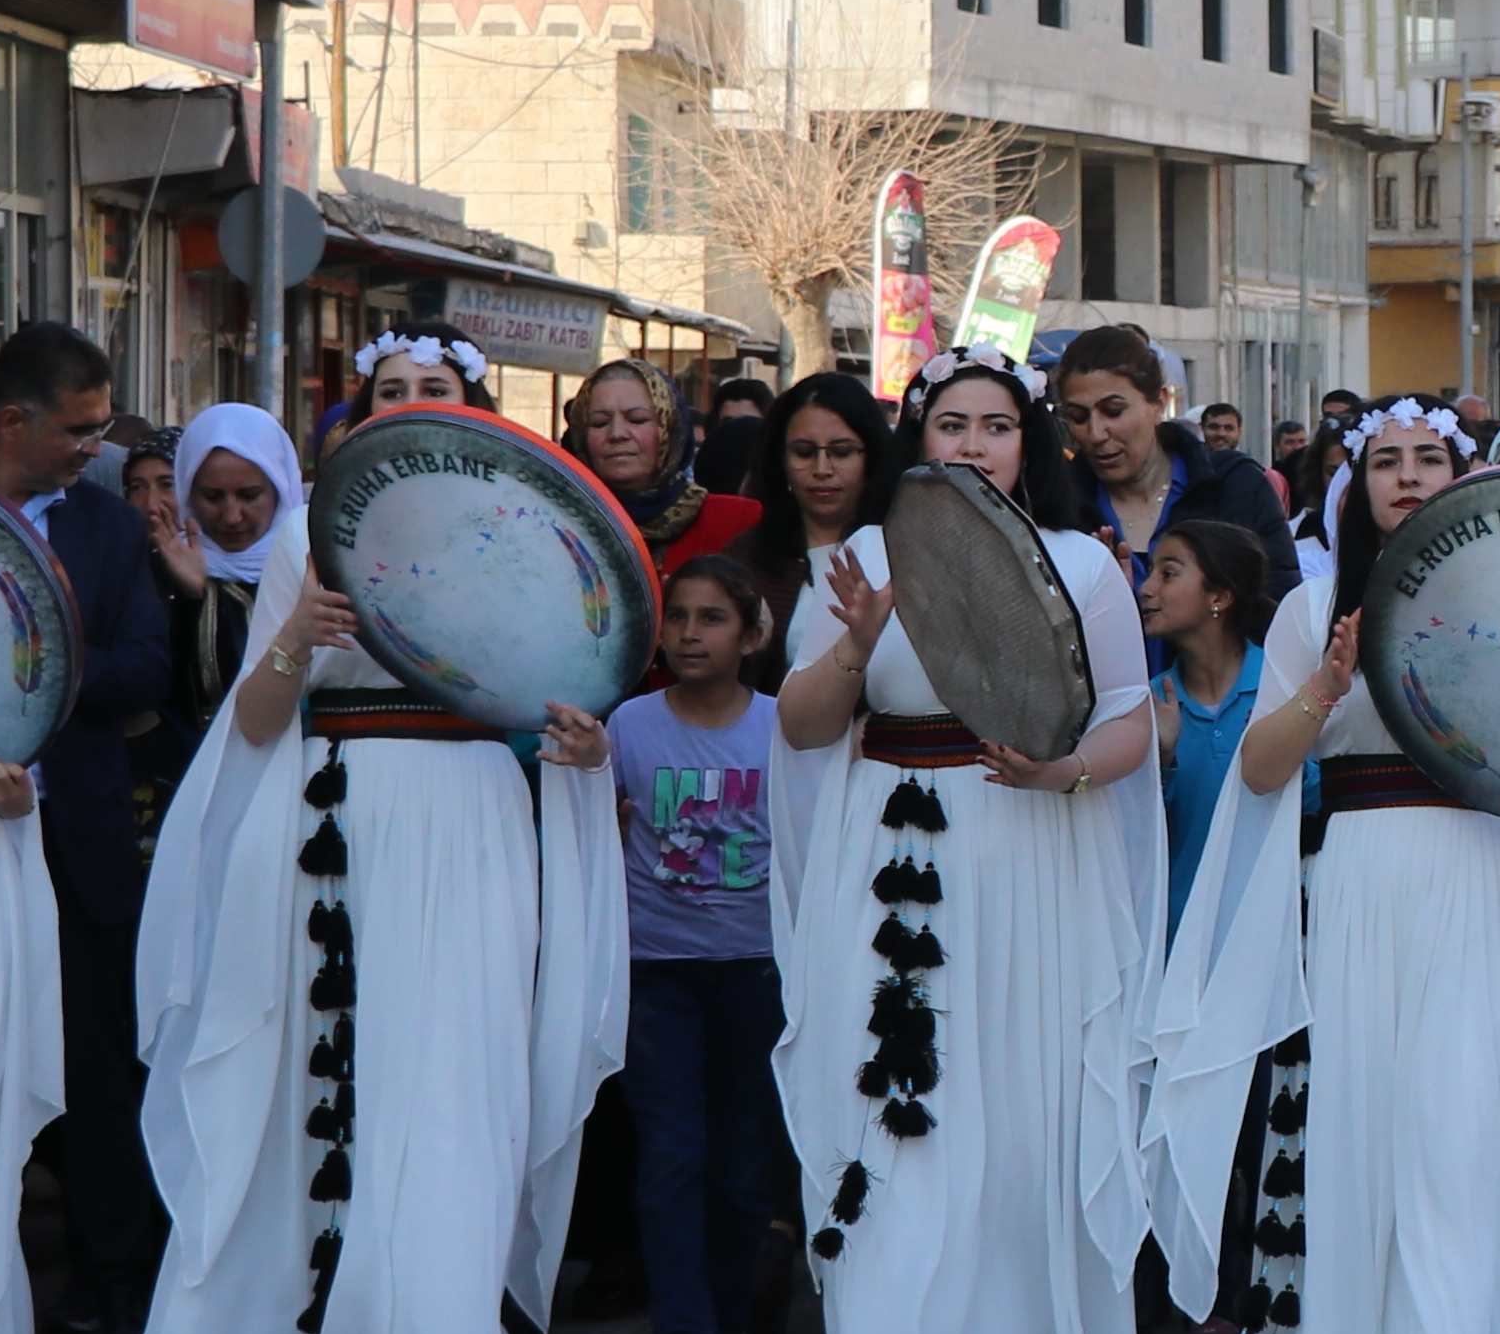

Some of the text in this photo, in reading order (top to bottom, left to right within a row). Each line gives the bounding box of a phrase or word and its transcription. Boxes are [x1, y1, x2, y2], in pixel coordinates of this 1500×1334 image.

[334, 452, 496, 550] EL-RUHA ERBANE
[1395, 513, 1493, 600] EL-RUHA
